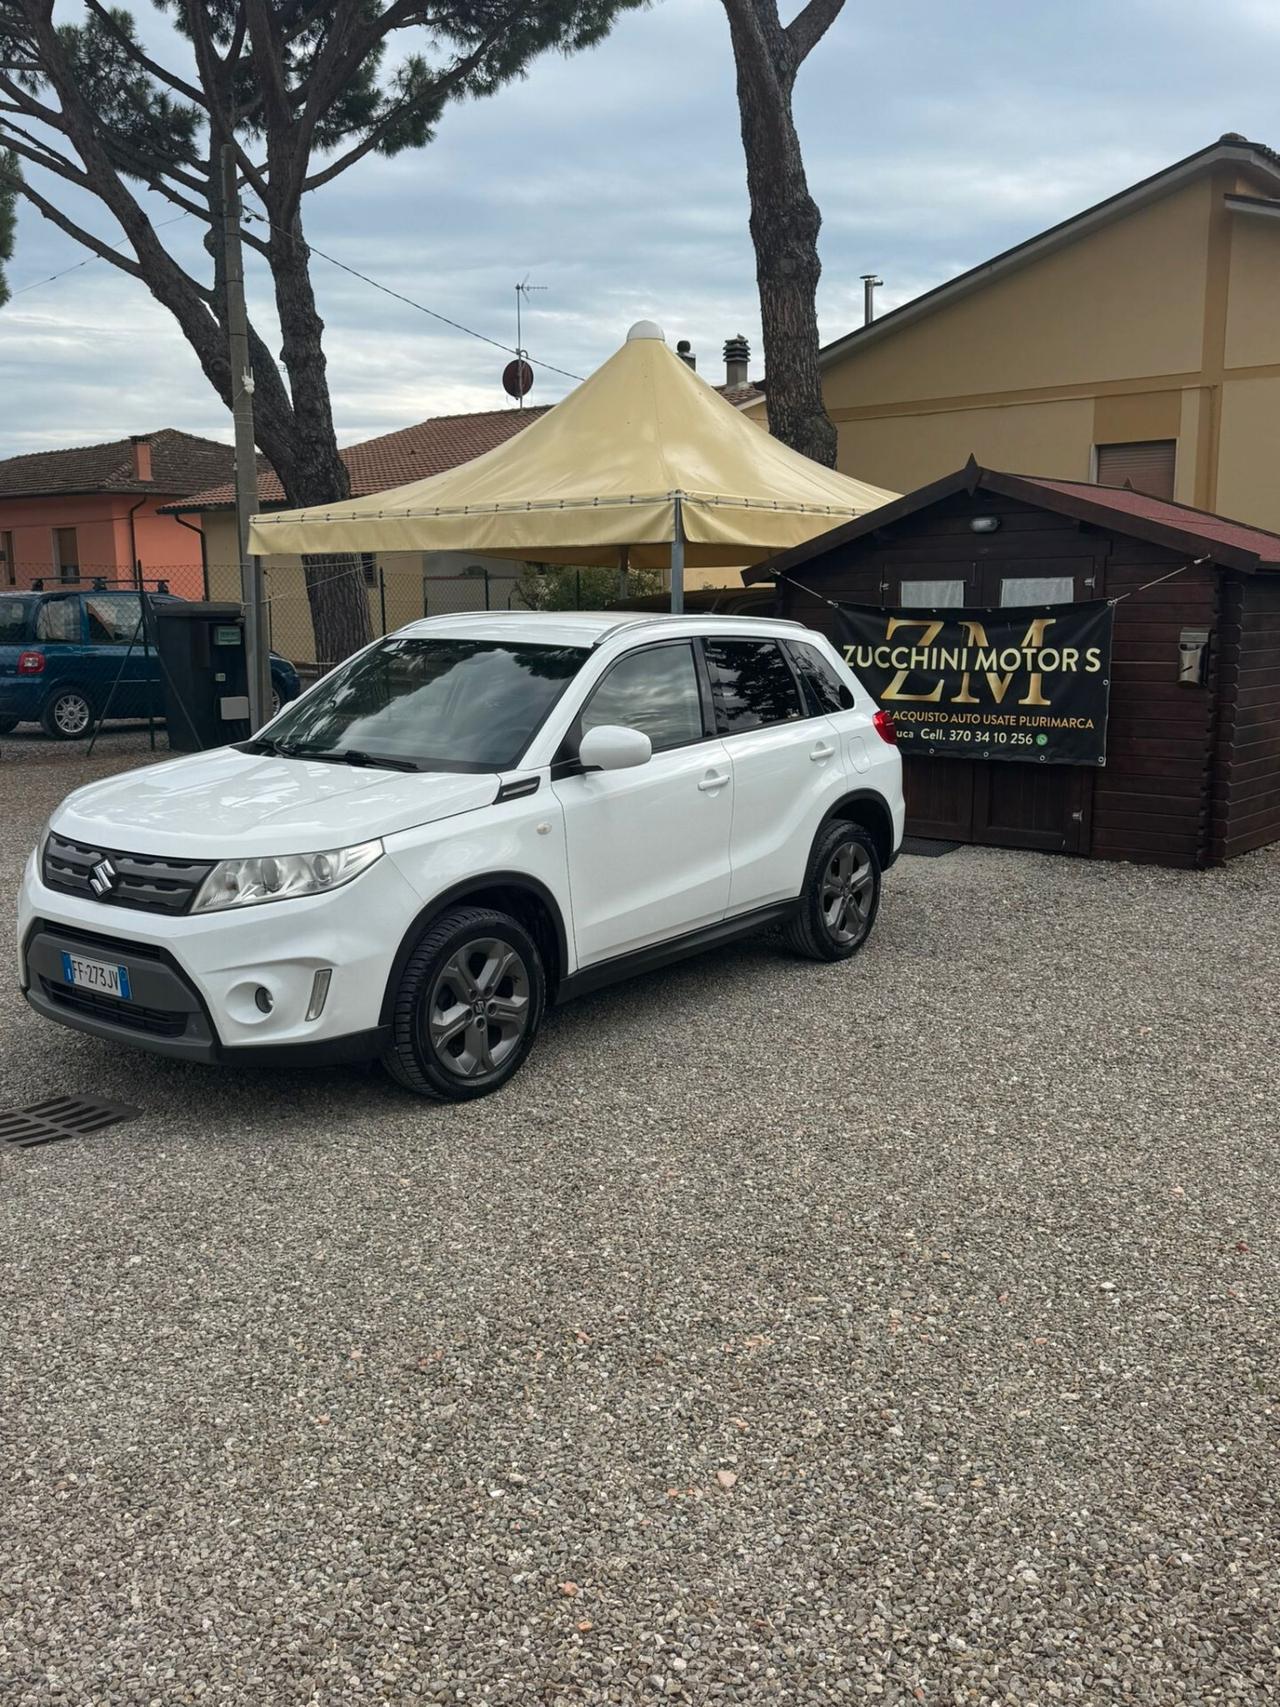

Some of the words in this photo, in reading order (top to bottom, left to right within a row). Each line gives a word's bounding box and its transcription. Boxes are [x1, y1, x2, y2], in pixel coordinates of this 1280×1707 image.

[843, 645, 968, 671] ZUCCHINI
[881, 617, 1056, 706] ZM
[892, 710, 949, 723] ACQUISTO
[950, 713, 980, 724] AUTO
[983, 714, 1017, 725] USATE
[1019, 717, 1094, 729] PLURIMARCA
[920, 728, 946, 740] Cell.
[949, 730, 972, 741] 370
[975, 731, 990, 743] 34
[994, 732, 1007, 743] 10
[1010, 733, 1033, 744] 256
